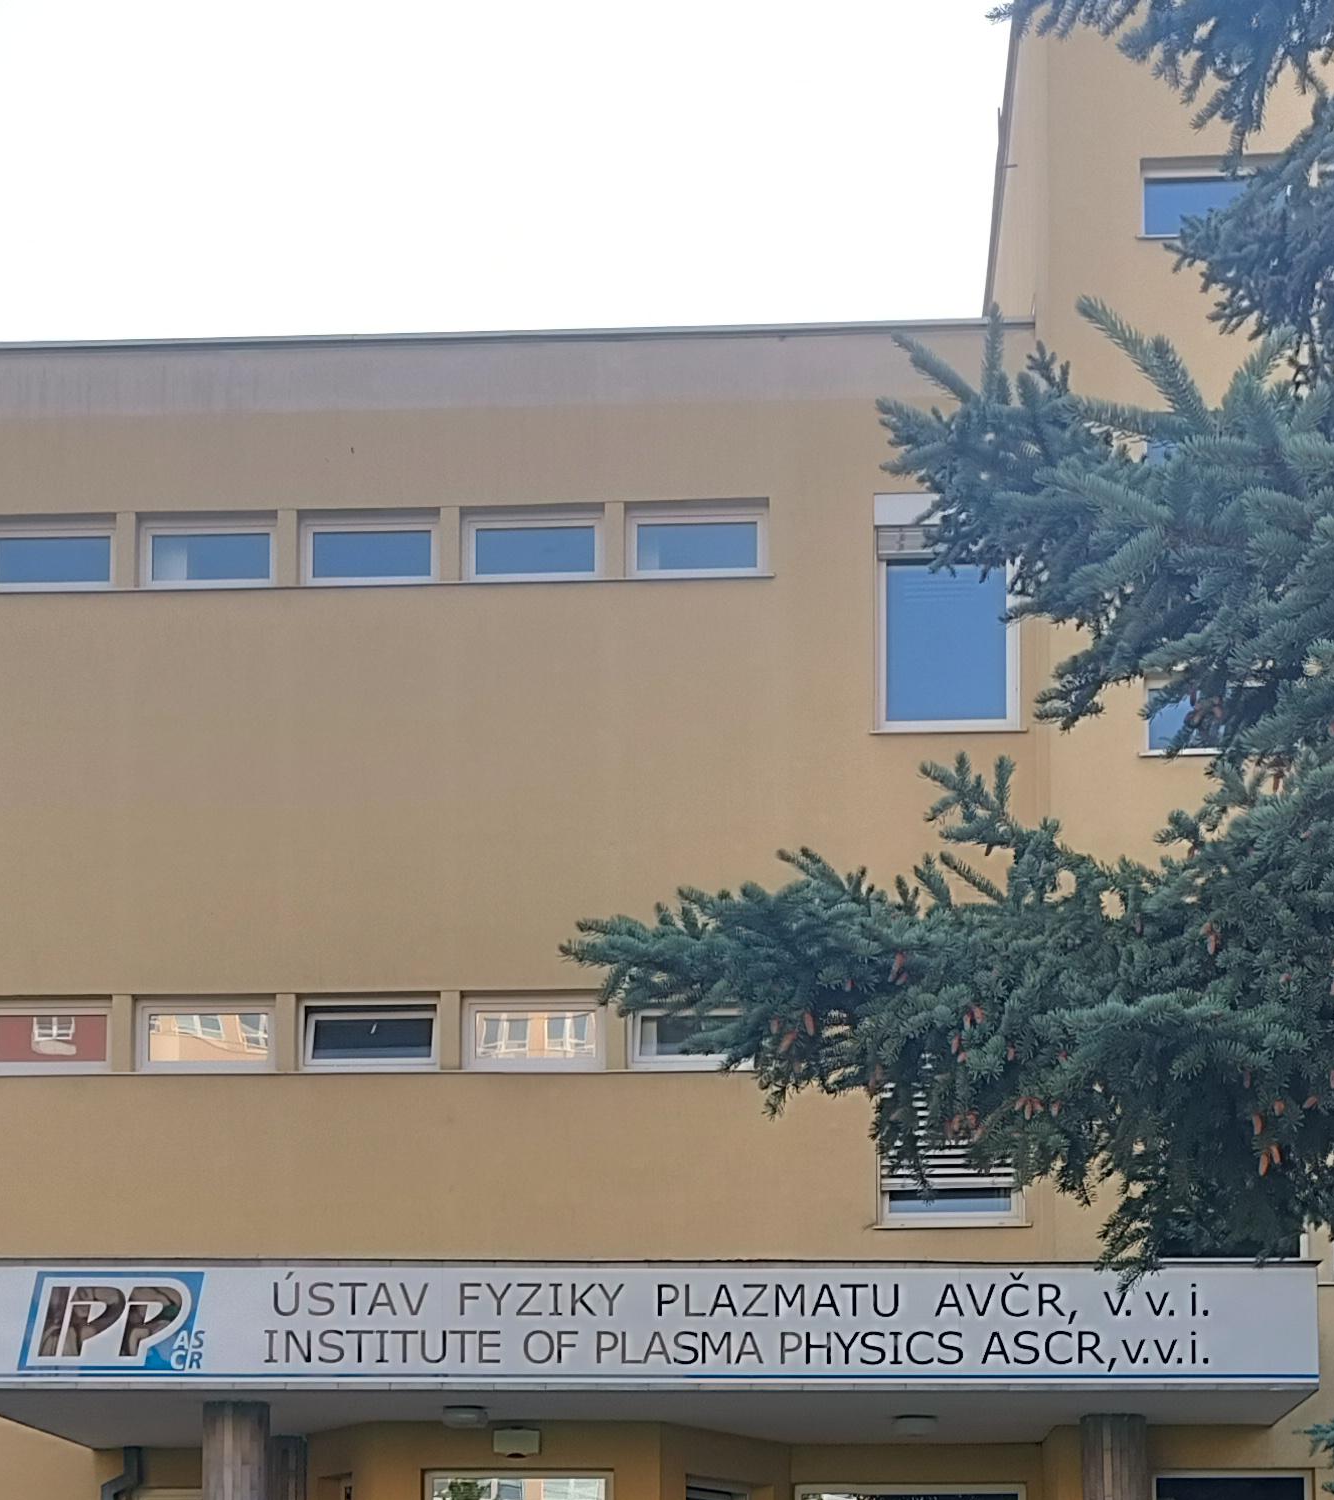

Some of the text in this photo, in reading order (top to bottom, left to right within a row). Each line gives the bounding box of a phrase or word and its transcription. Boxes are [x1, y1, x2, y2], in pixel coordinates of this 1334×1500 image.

[273, 1271, 429, 1317] ÚSTAV
[459, 1282, 625, 1317] FYZIKY
[657, 1283, 900, 1318] PLAZMATU
[934, 1271, 1078, 1326] AVČR,
[37, 1285, 183, 1357] IPP
[172, 1330, 206, 1350] AS
[263, 1329, 501, 1364] INSTITUTE
[523, 1329, 579, 1365] OF
[596, 1330, 764, 1365] PLASMA
[780, 1331, 964, 1366] PHYSICS
[170, 1350, 204, 1370] CR
